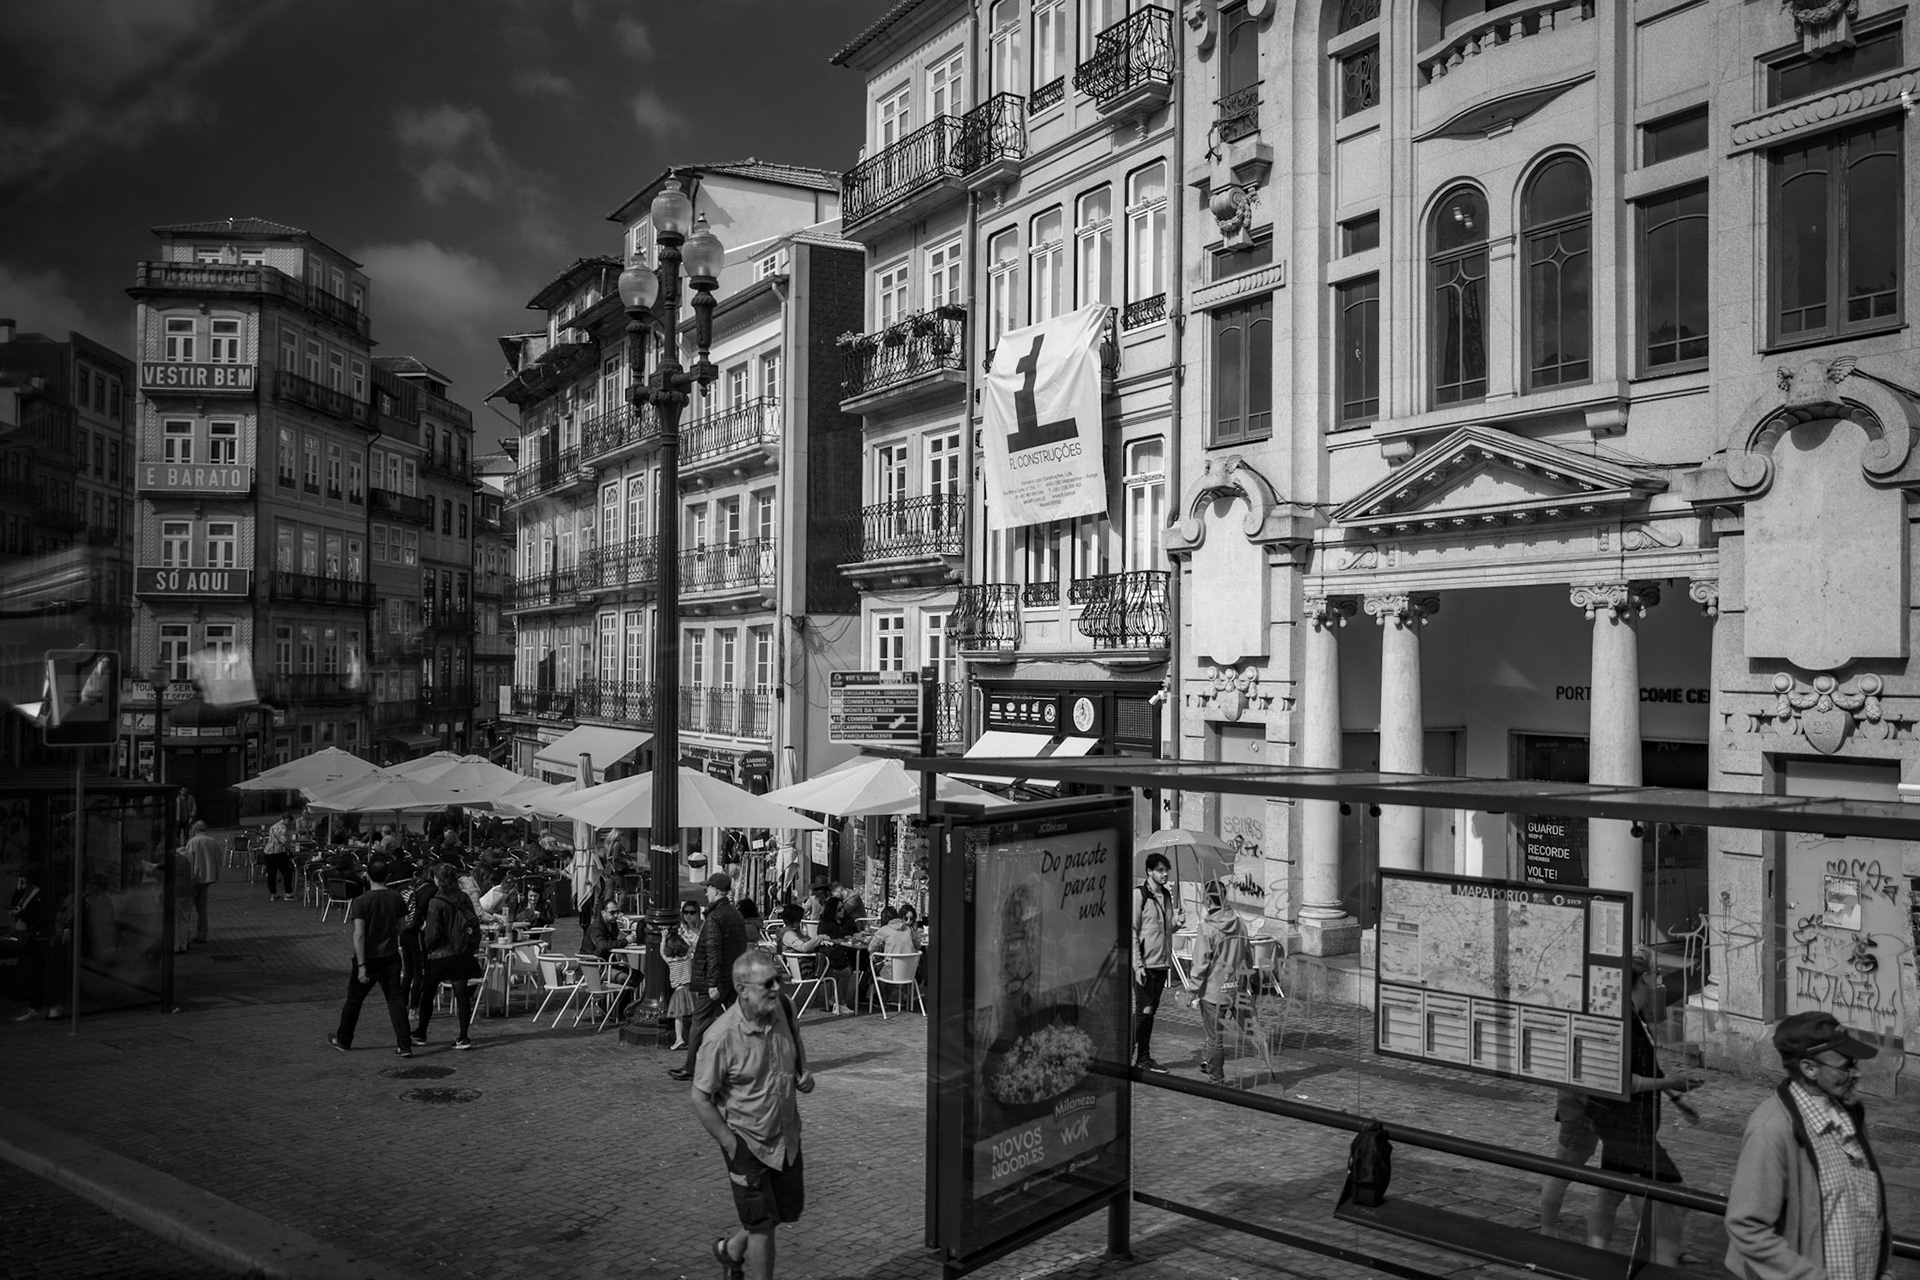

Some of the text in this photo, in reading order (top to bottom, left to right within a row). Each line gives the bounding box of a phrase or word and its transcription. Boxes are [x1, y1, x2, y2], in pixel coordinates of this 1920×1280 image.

[143, 365, 251, 387] VESTIR BEM
[1017, 442, 1083, 469] CONSTRUÇÕES
[146, 467, 241, 488] E BARATO
[155, 568, 230, 591] SÓ AQUI
[1555, 685, 1592, 701] PORT
[1638, 686, 1684, 704] COME
[1527, 821, 1566, 837] GUARDE
[1041, 842, 1107, 882] Do pacote
[1527, 844, 1570, 860] RECORDE
[1527, 865, 1558, 880] VOLTE!
[1060, 874, 1107, 910] para o
[1456, 884, 1490, 900] MAPA
[1491, 888, 1529, 904] PORTO
[1078, 889, 1107, 920] wok
[1054, 1095, 1096, 1118] Milaneza
[1060, 1114, 1091, 1146] WOK
[991, 1126, 1043, 1164] NOVOS
[991, 1146, 1045, 1180] NOODLES
